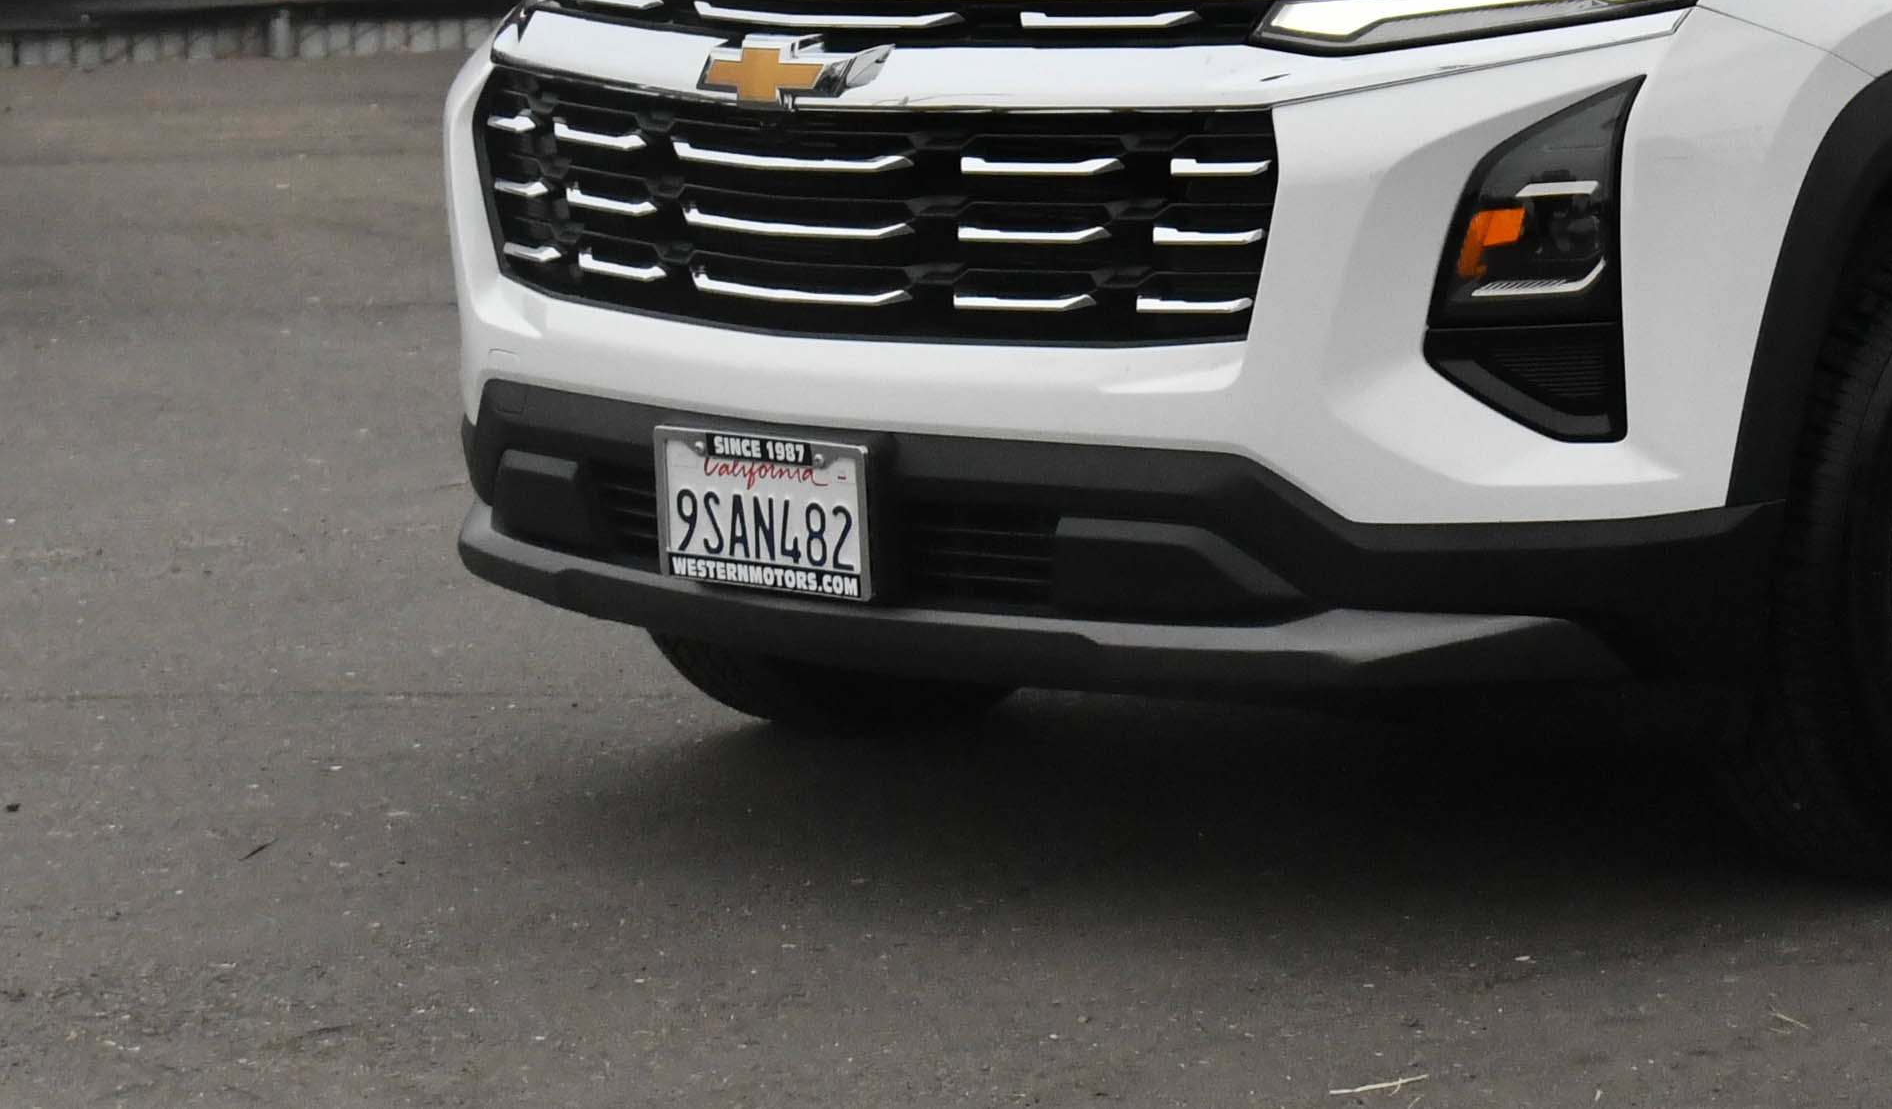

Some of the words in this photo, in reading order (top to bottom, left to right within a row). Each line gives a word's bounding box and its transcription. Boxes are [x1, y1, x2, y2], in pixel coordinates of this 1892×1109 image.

[713, 436, 762, 459] SINCE
[766, 442, 804, 463] 1987
[703, 457, 828, 491] California
[676, 489, 855, 572] 9SAN482
[671, 556, 859, 597] WESTERNMOTORS.COM
